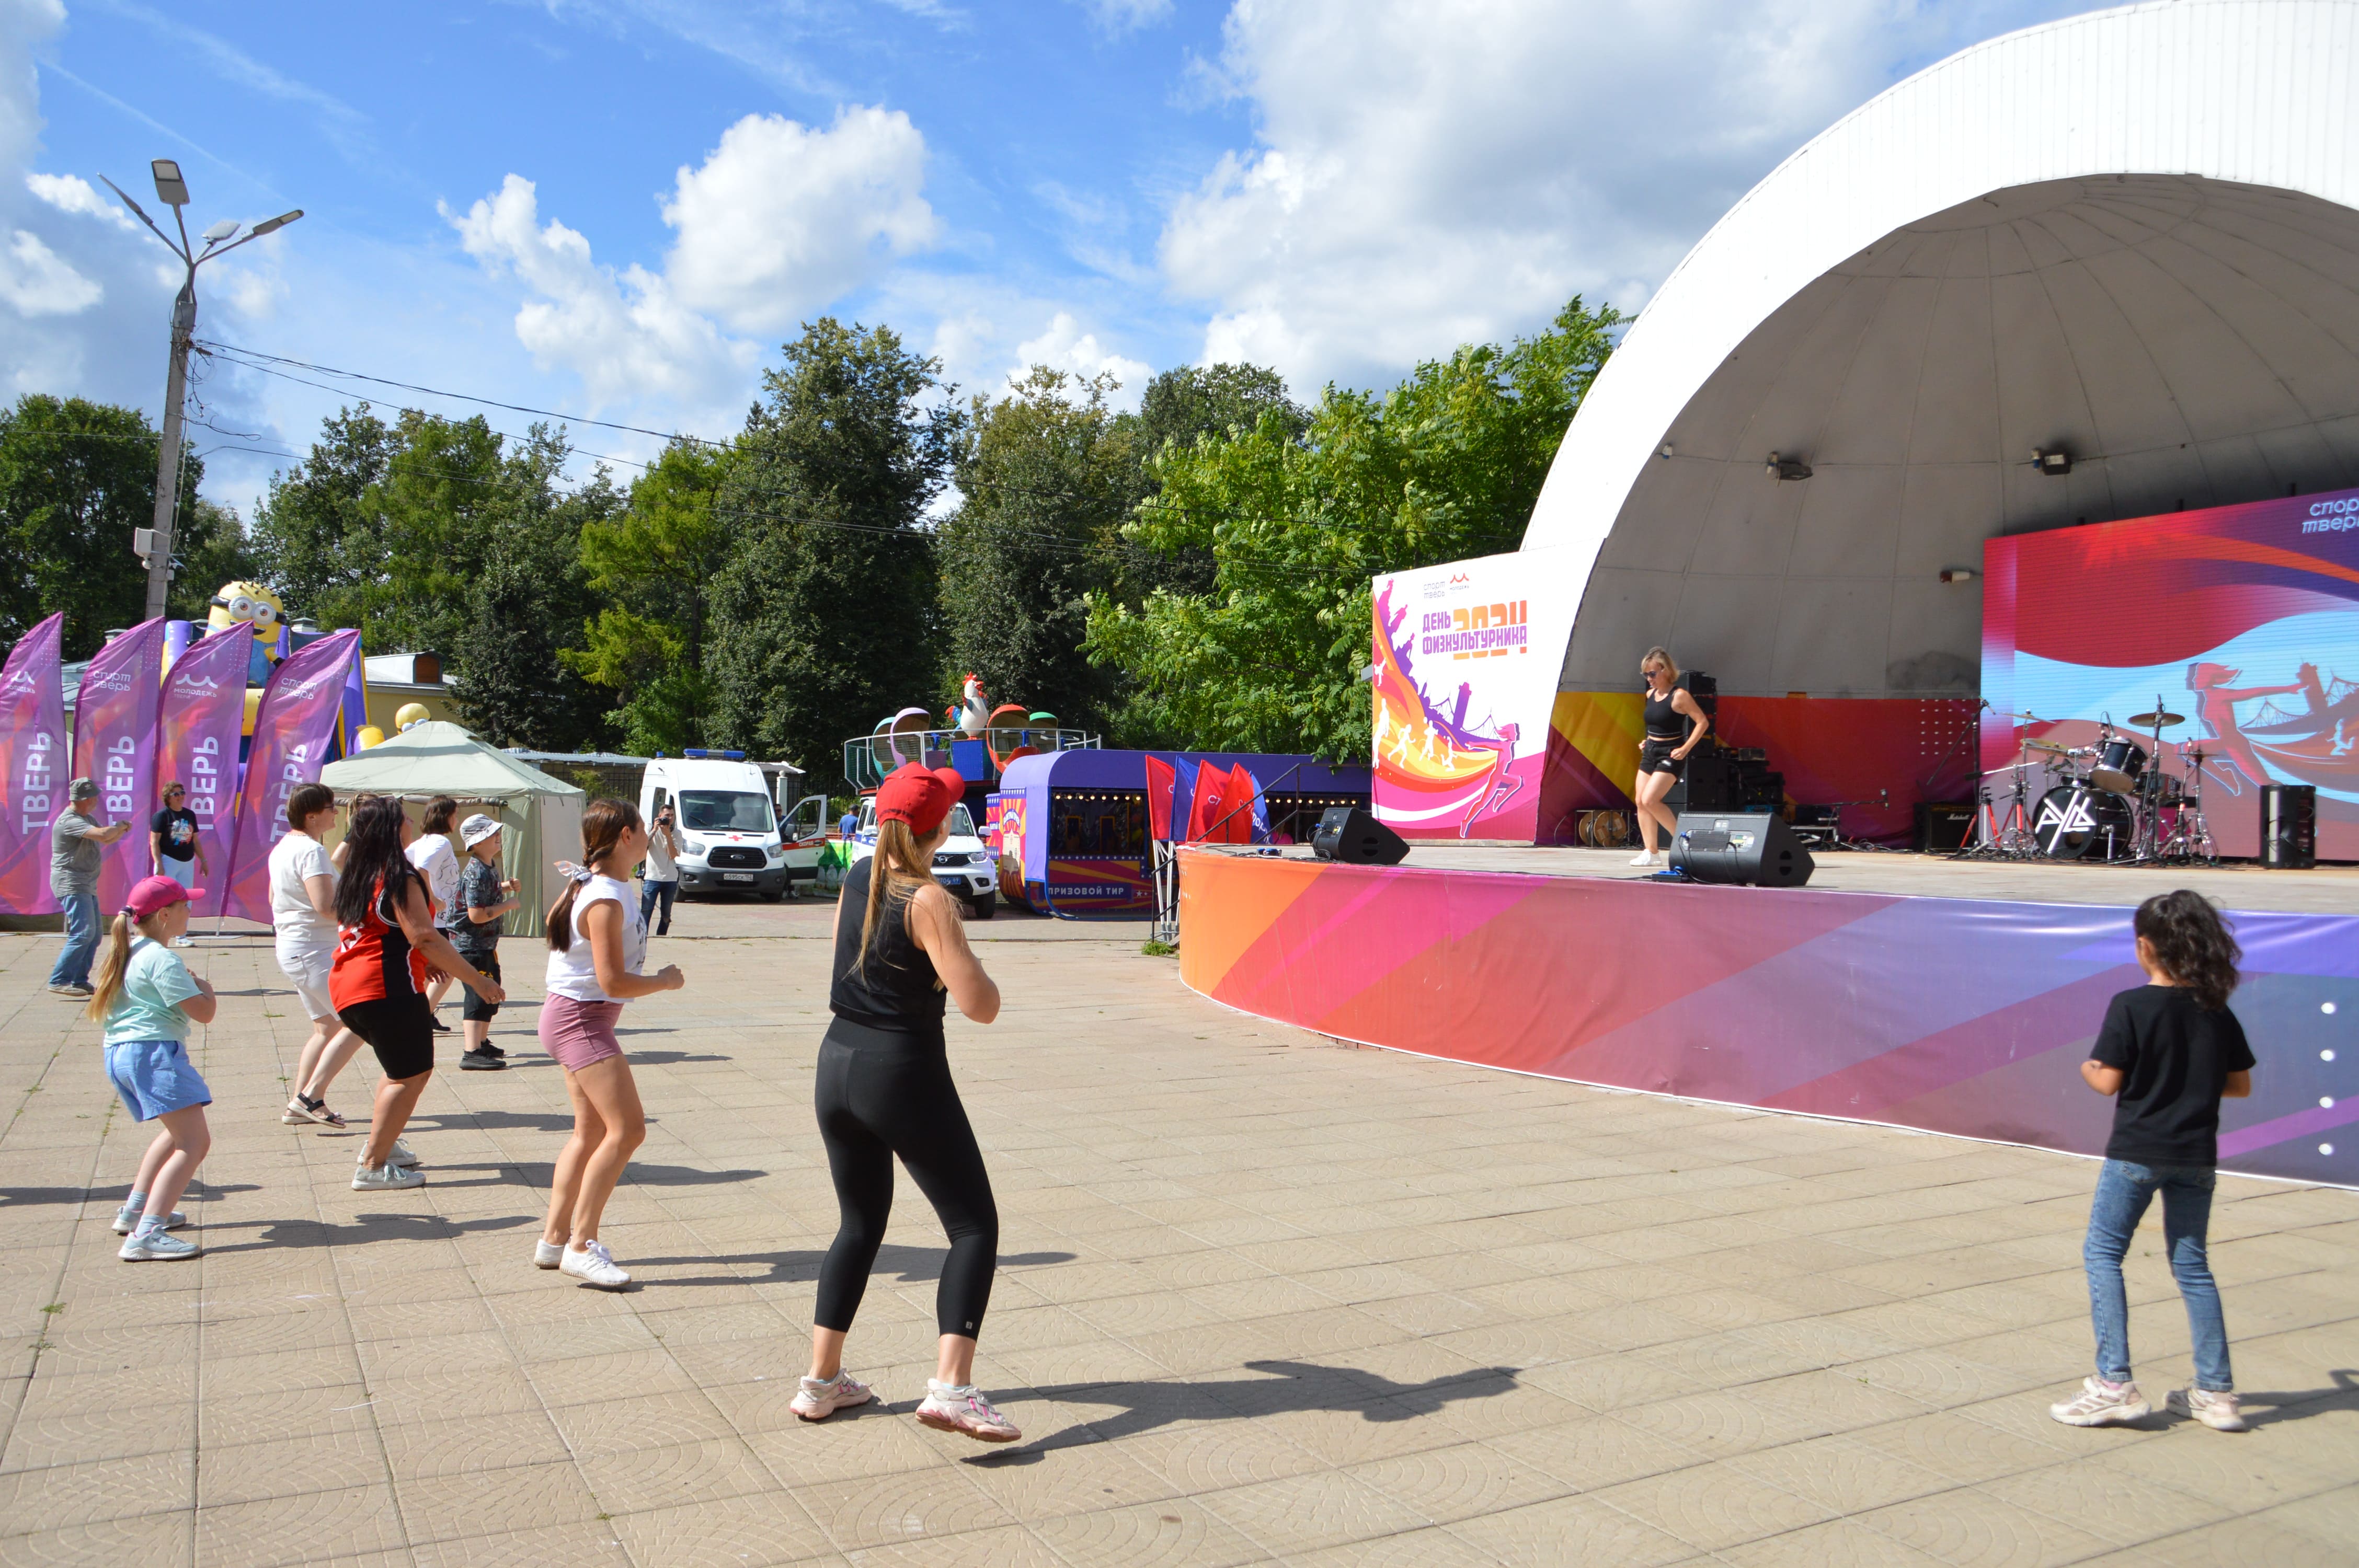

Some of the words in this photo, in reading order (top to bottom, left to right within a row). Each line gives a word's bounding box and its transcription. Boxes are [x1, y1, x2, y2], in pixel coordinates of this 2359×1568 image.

[2302, 516, 2359, 534] твер
[1423, 581, 1445, 591] спорт
[1423, 591, 1445, 599] тверь
[1423, 611, 1451, 633] ДЕНЬ
[1423, 625, 1527, 655] ФИЗКУЛЬТУРНИКА
[281, 677, 317, 690] спорт
[174, 688, 217, 698] МОЛОДЕЖЬ
[22, 732, 51, 834] ТВЕРЬ
[1048, 886, 1102, 895] ПРИЗОВОЙ
[1106, 887, 1124, 895] ТИР
